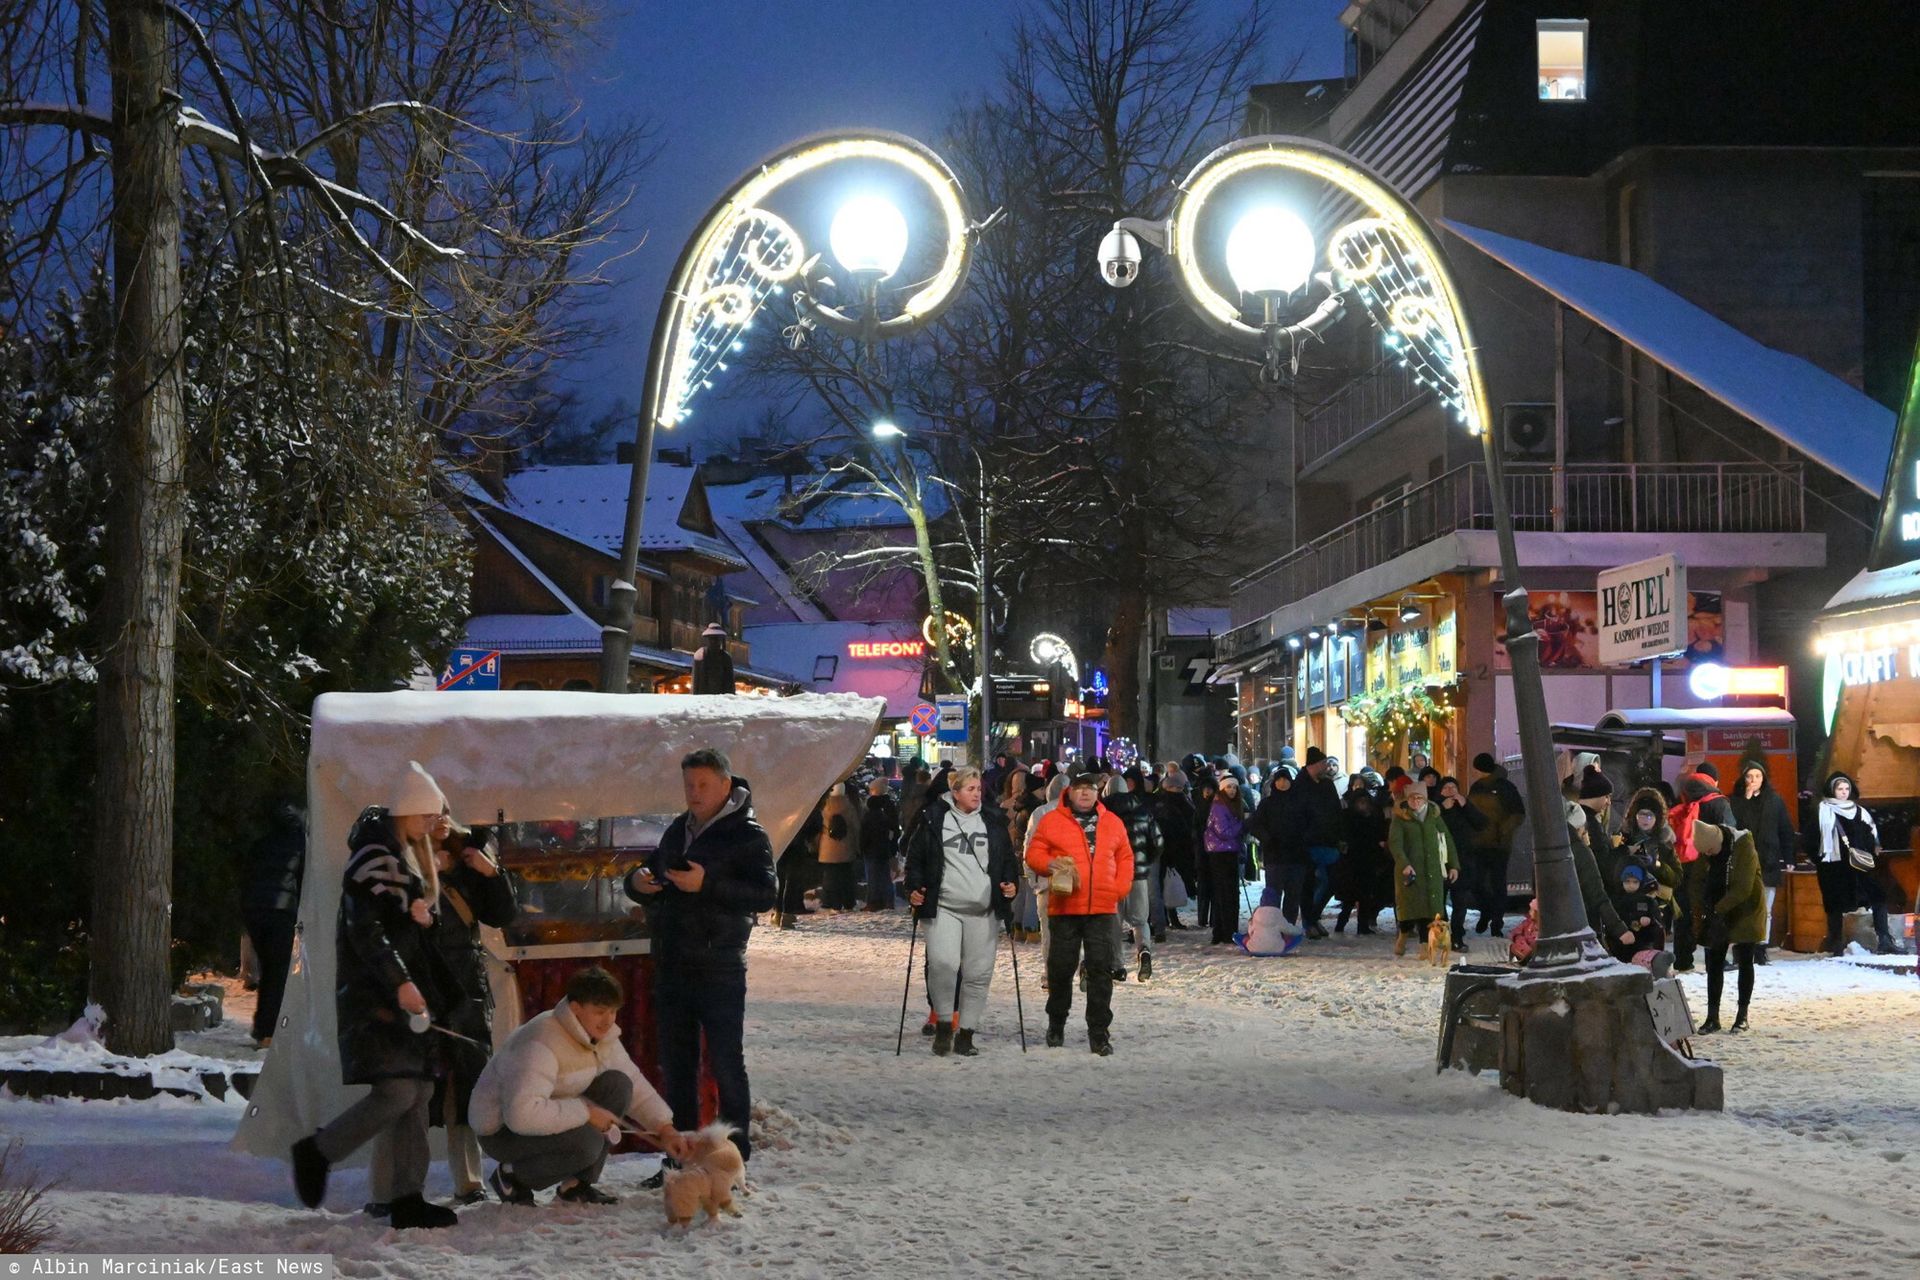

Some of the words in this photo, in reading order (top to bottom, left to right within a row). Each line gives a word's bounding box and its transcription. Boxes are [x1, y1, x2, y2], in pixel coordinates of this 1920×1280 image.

[1602, 574, 1670, 628] HOTEL
[1614, 625, 1646, 644] KASPROWY
[1647, 620, 1670, 637] WIERCH
[848, 641, 924, 657] TELEFONY
